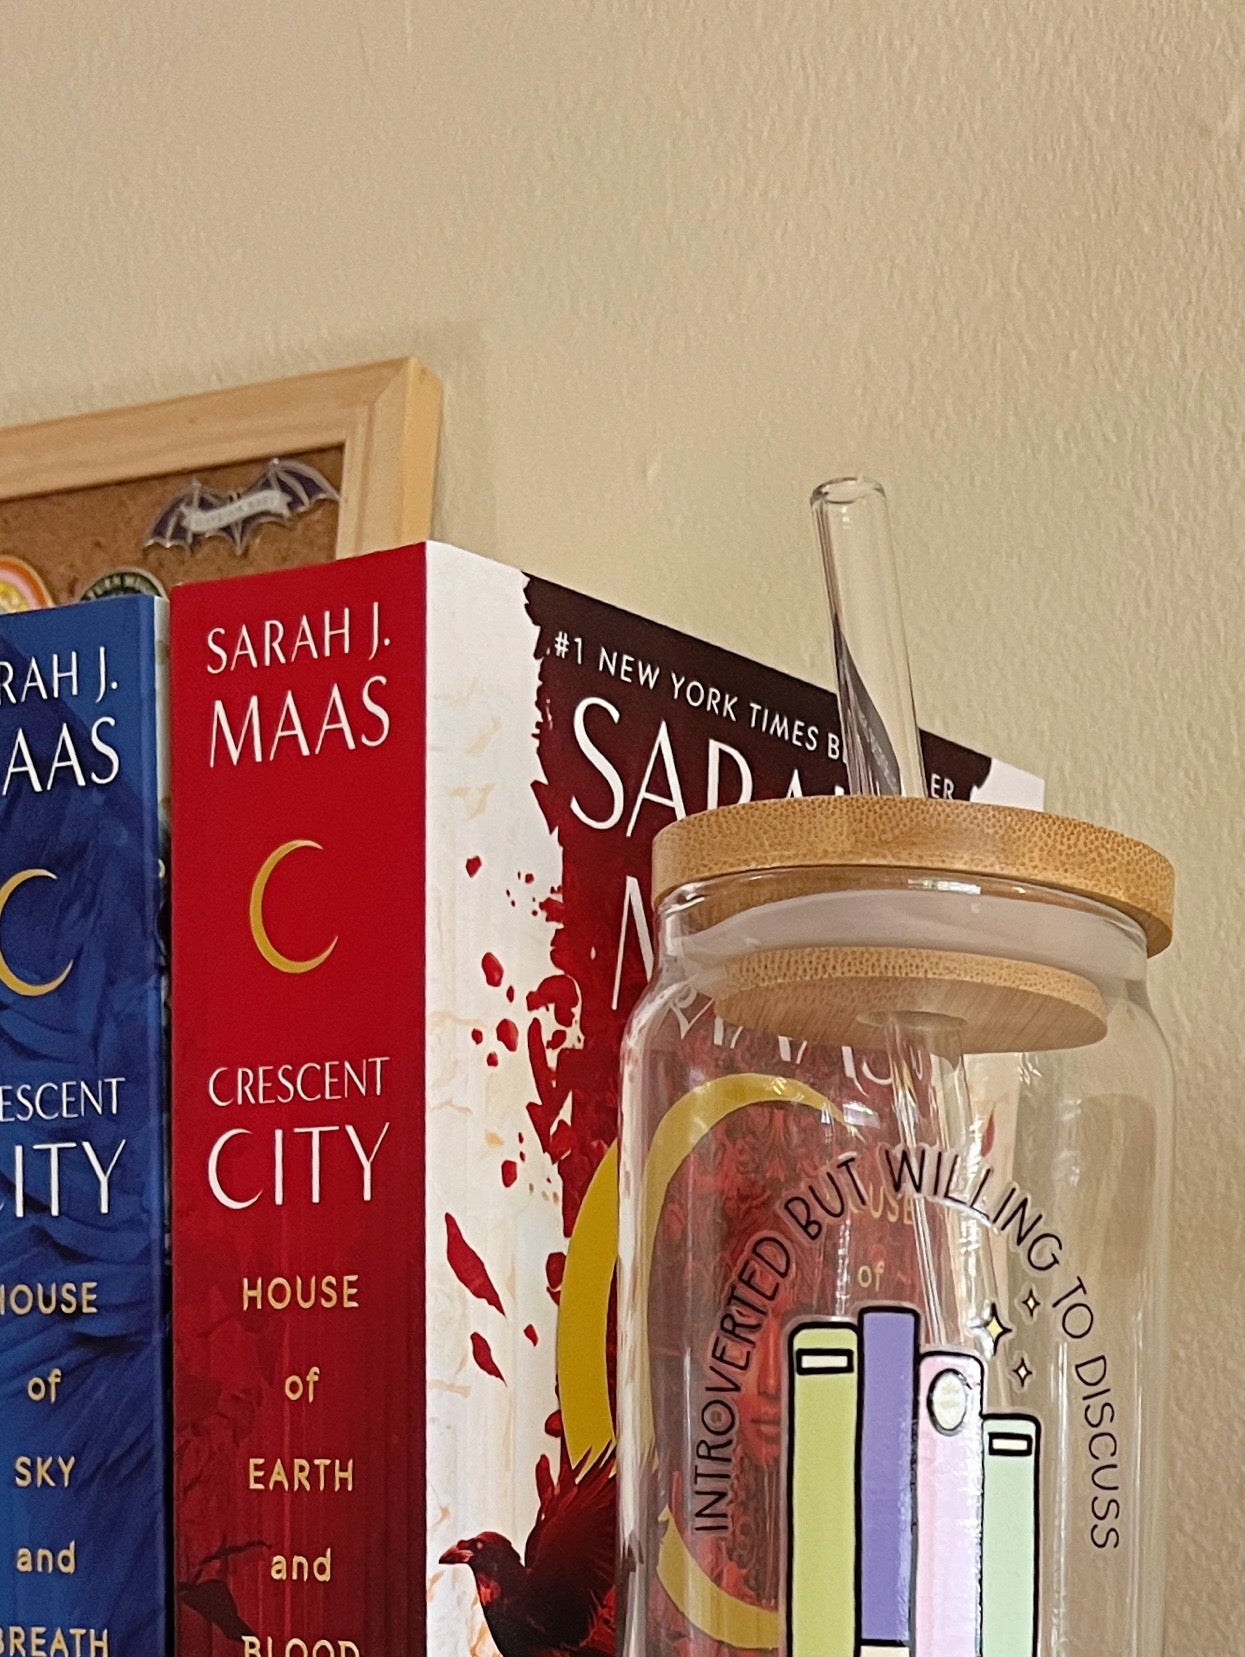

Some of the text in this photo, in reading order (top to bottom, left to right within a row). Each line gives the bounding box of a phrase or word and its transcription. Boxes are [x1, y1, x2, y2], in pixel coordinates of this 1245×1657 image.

[206, 601, 391, 674] SARAH J.
[0, 645, 119, 705] RAH J.
[554, 631, 583, 665] #1
[598, 646, 661, 690] NEW
[671, 671, 739, 722] YORK
[749, 702, 819, 752] TIMES
[209, 675, 390, 768] MAAS
[2, 716, 120, 797] AAS
[0, 1077, 126, 1122] ESCENT
[208, 1056, 391, 1107] CRESCENT
[0, 1138, 127, 1218] ITY
[207, 1121, 390, 1210] CITY
[242, 1274, 360, 1312] HOUSE
[858, 1260, 887, 1293] of
[694, 1148, 1120, 1550] INTROVERTED BUT WILLING TO DISCUSS
[27, 1366, 62, 1404] of
[284, 1366, 321, 1404] of
[15, 1455, 76, 1488] SKY
[248, 1457, 355, 1492] EARTH
[16, 1539, 76, 1575] and
[270, 1547, 333, 1583] and
